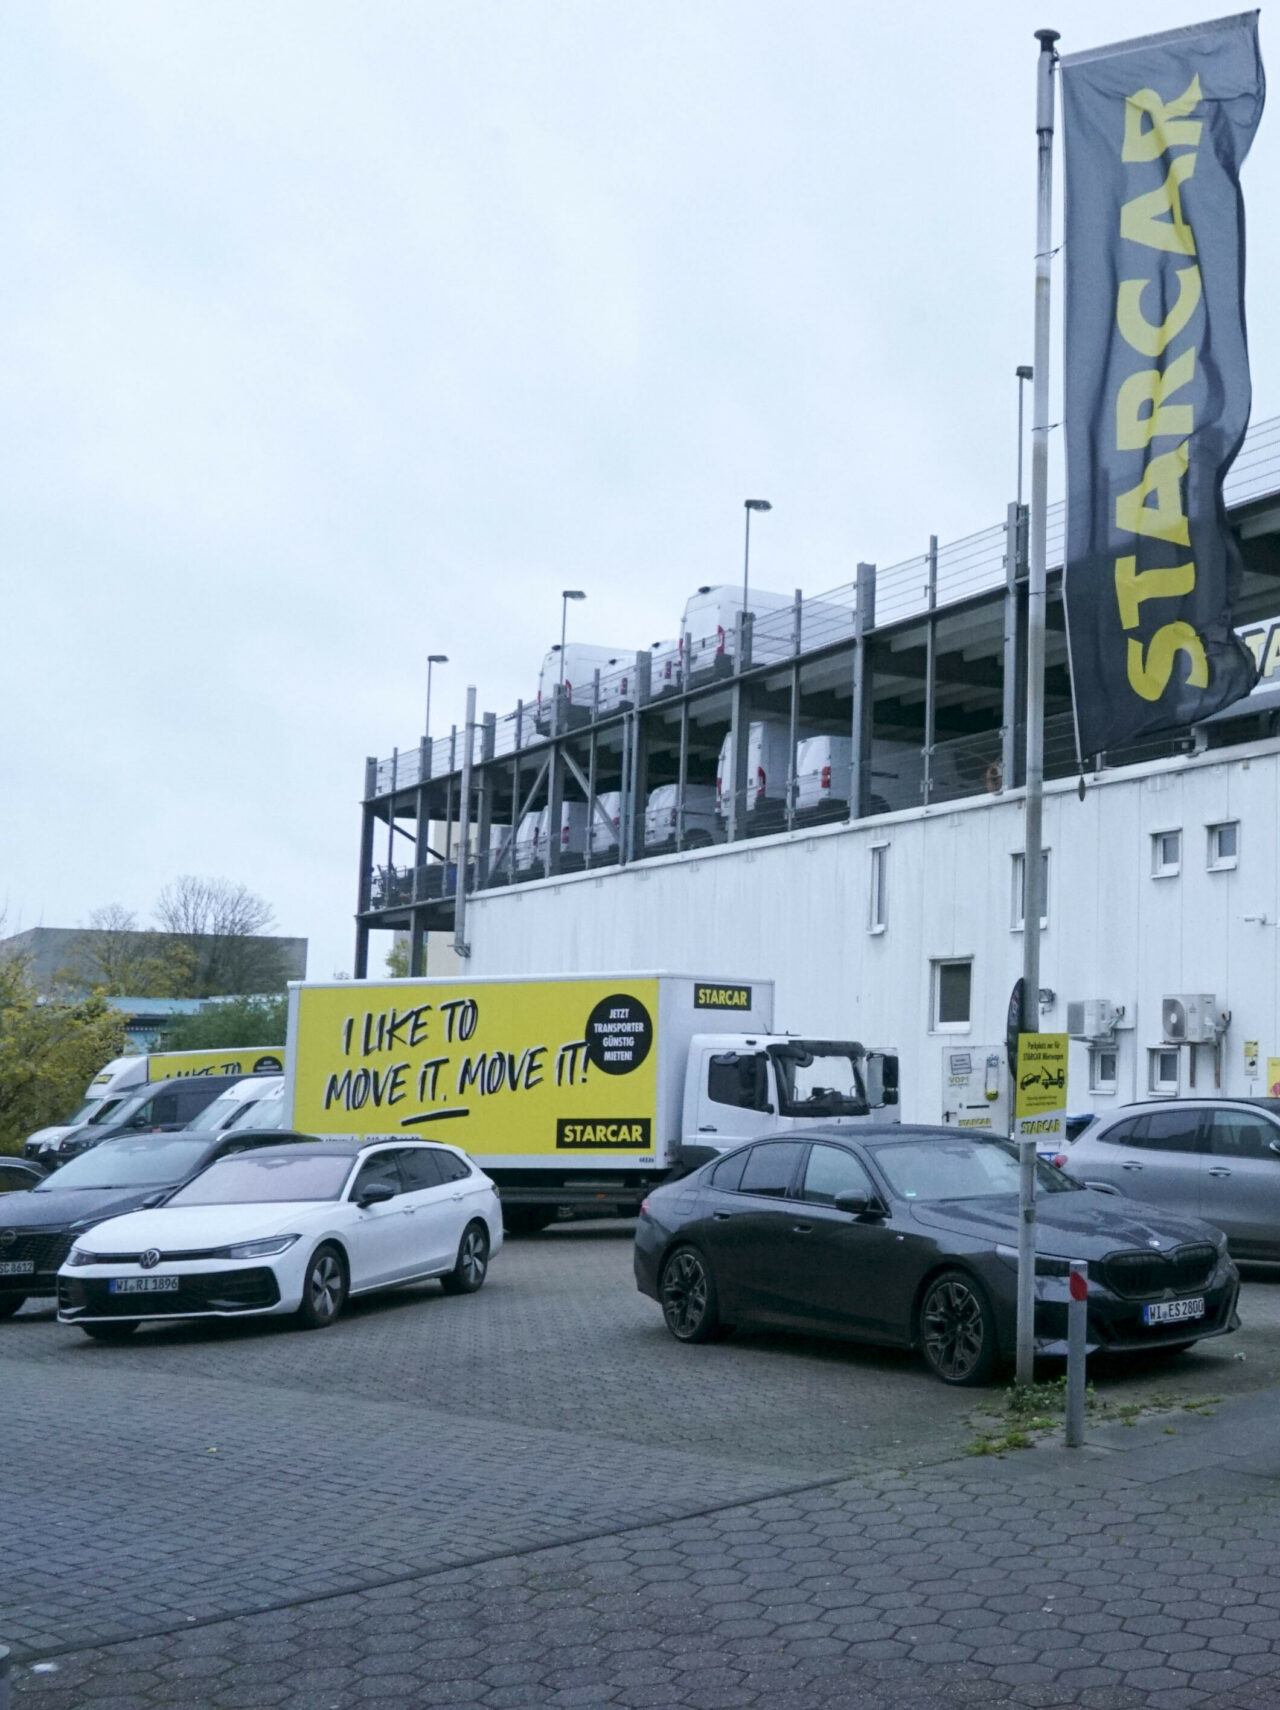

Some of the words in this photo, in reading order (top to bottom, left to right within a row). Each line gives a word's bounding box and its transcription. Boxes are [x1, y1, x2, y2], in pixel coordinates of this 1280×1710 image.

[1115, 73, 1209, 702] STARCAR
[698, 989, 748, 1006] STARCAR
[609, 1008, 629, 1019] JETZT
[342, 1017, 353, 1055] I
[362, 1004, 432, 1056] LIKE
[439, 998, 478, 1042] TO
[594, 1022, 644, 1033] TRANSPORTER
[602, 1035, 634, 1047] GÜNSTIG
[604, 1051, 633, 1061] MIETEN!
[323, 1063, 411, 1111] MOVE
[456, 1046, 549, 1096] MOVE
[555, 1040, 591, 1087] IT!
[563, 1125, 643, 1142] STARCAR
[1021, 1119, 1060, 1134] STARCAR
[116, 1279, 129, 1292] WI
[136, 1278, 149, 1291] RI
[152, 1277, 178, 1291] 1896
[1168, 1303, 1180, 1317] ES
